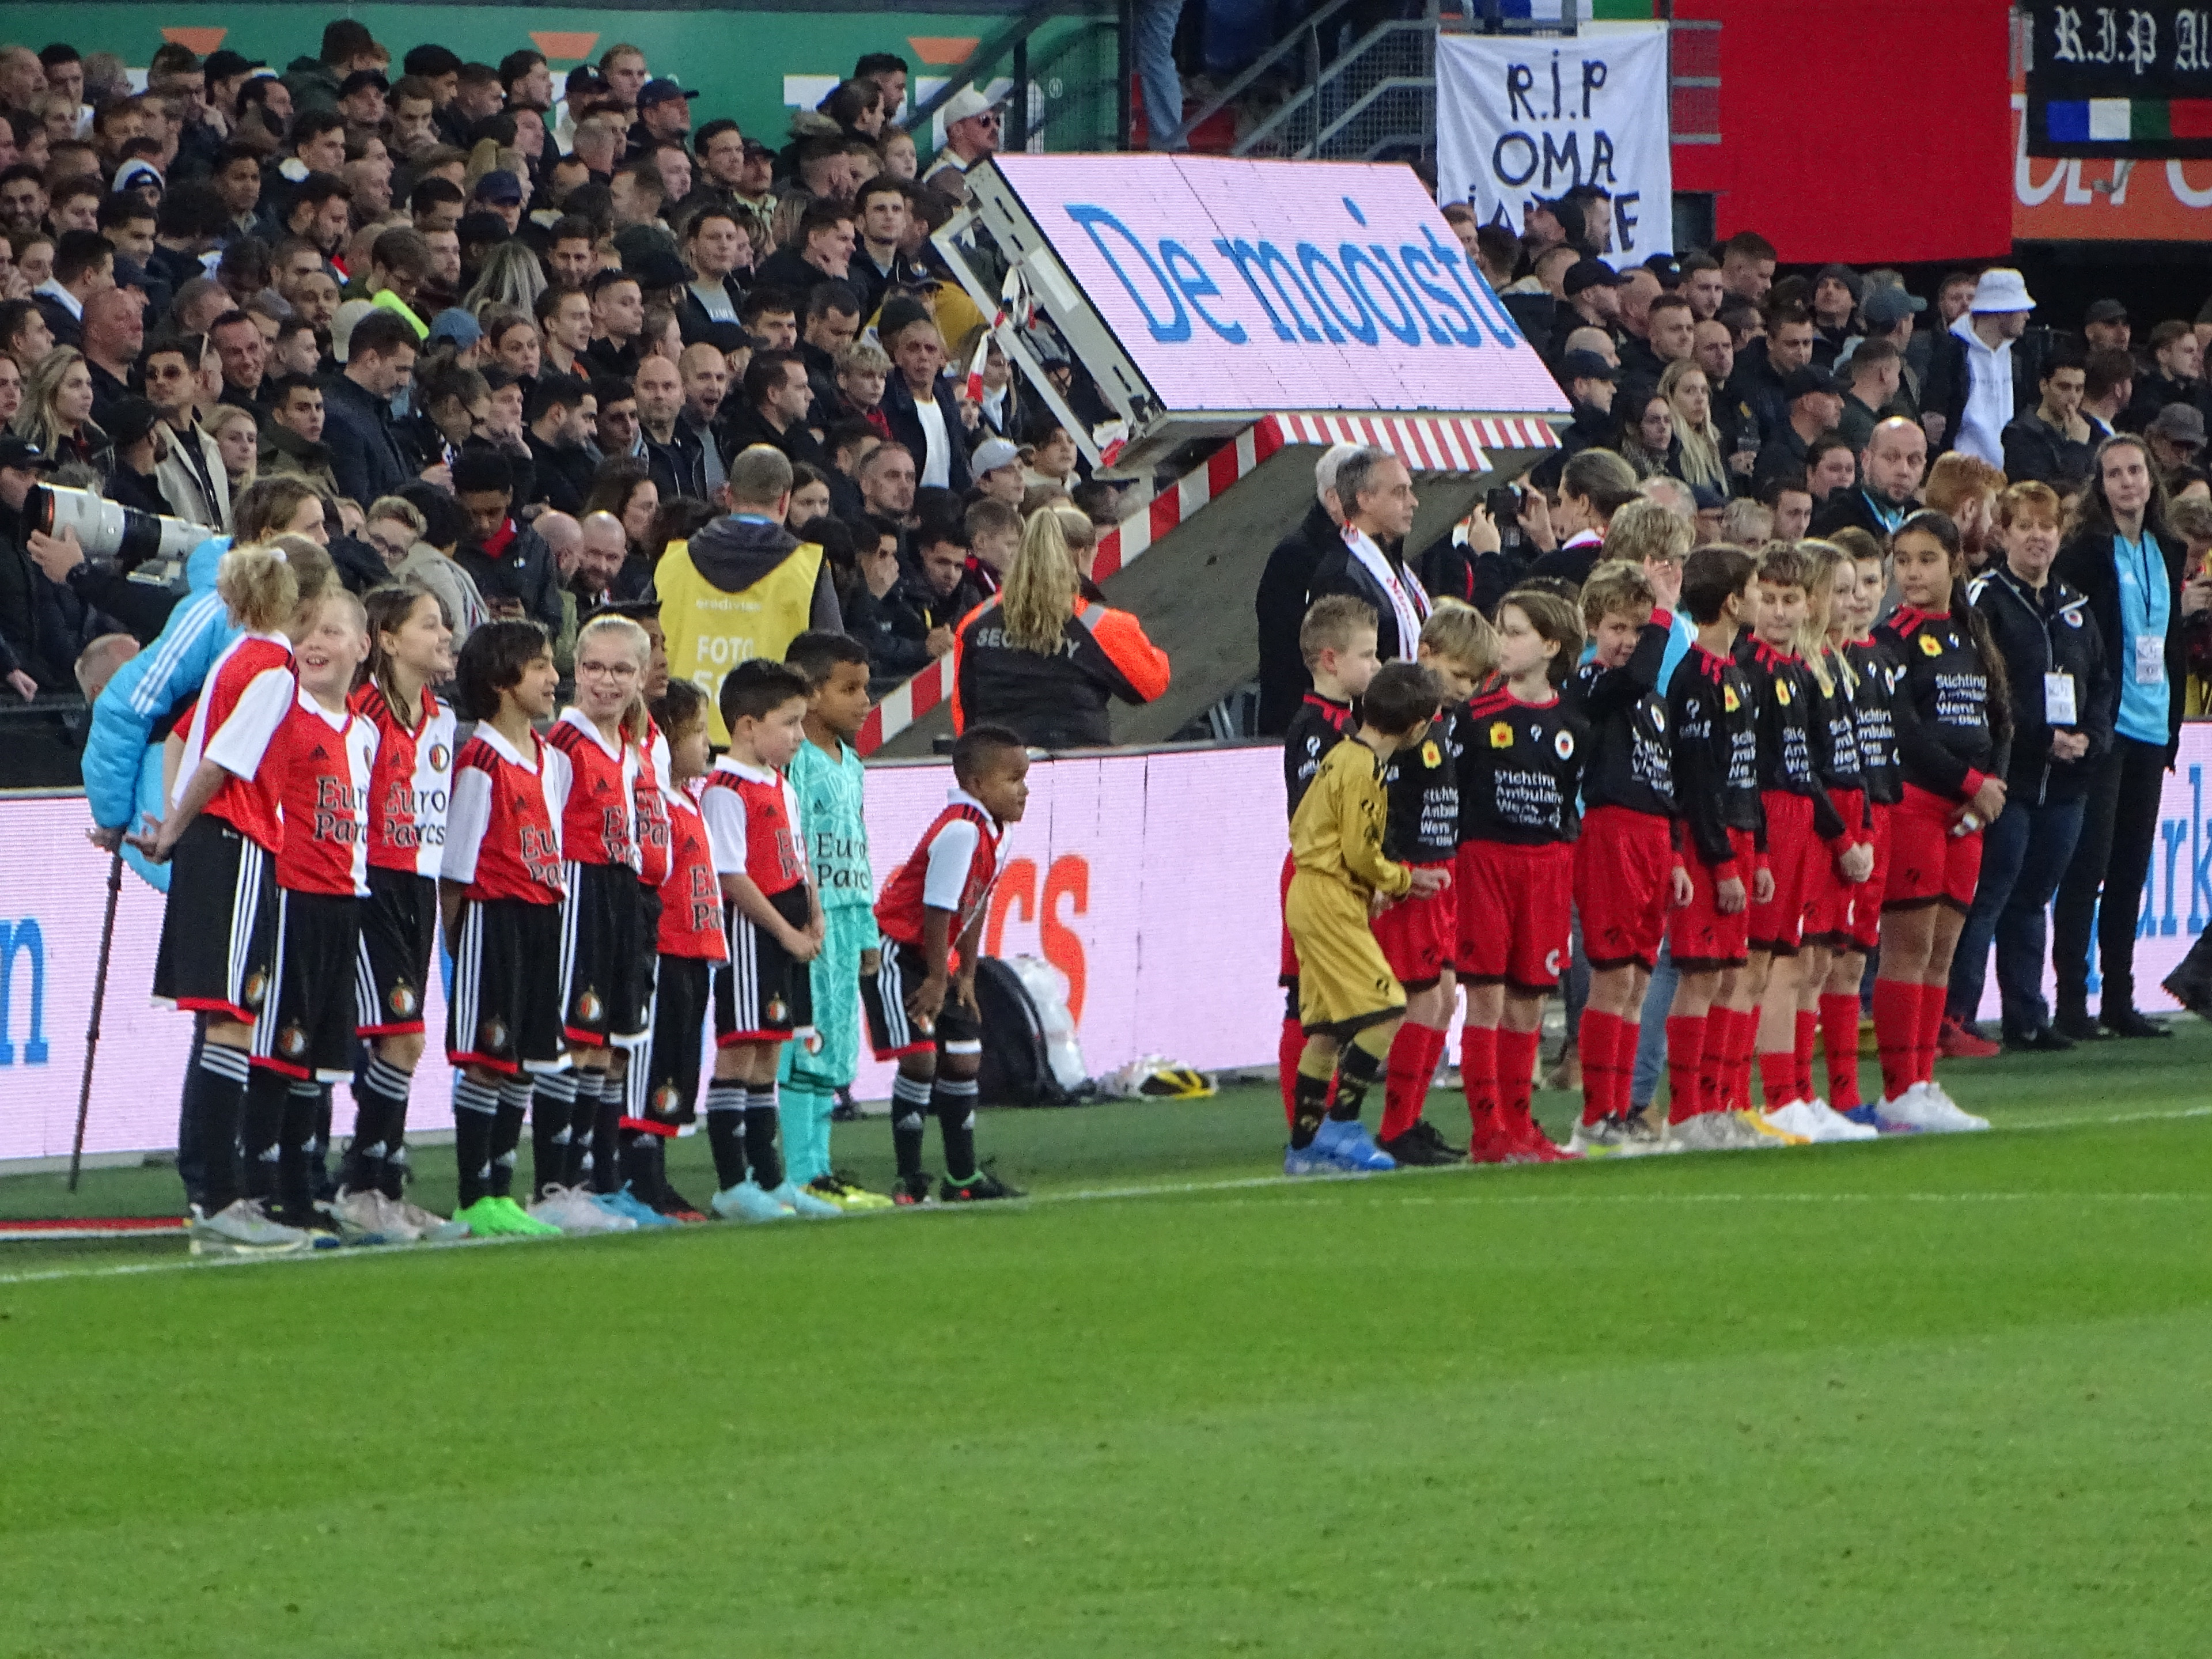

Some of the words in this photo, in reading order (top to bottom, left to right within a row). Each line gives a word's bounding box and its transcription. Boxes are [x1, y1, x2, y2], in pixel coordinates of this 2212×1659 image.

[1493, 129, 1616, 190] OMA
[1064, 202, 1248, 344] De
[384, 782, 446, 814] Euro
[382, 817, 445, 847] Parcs
